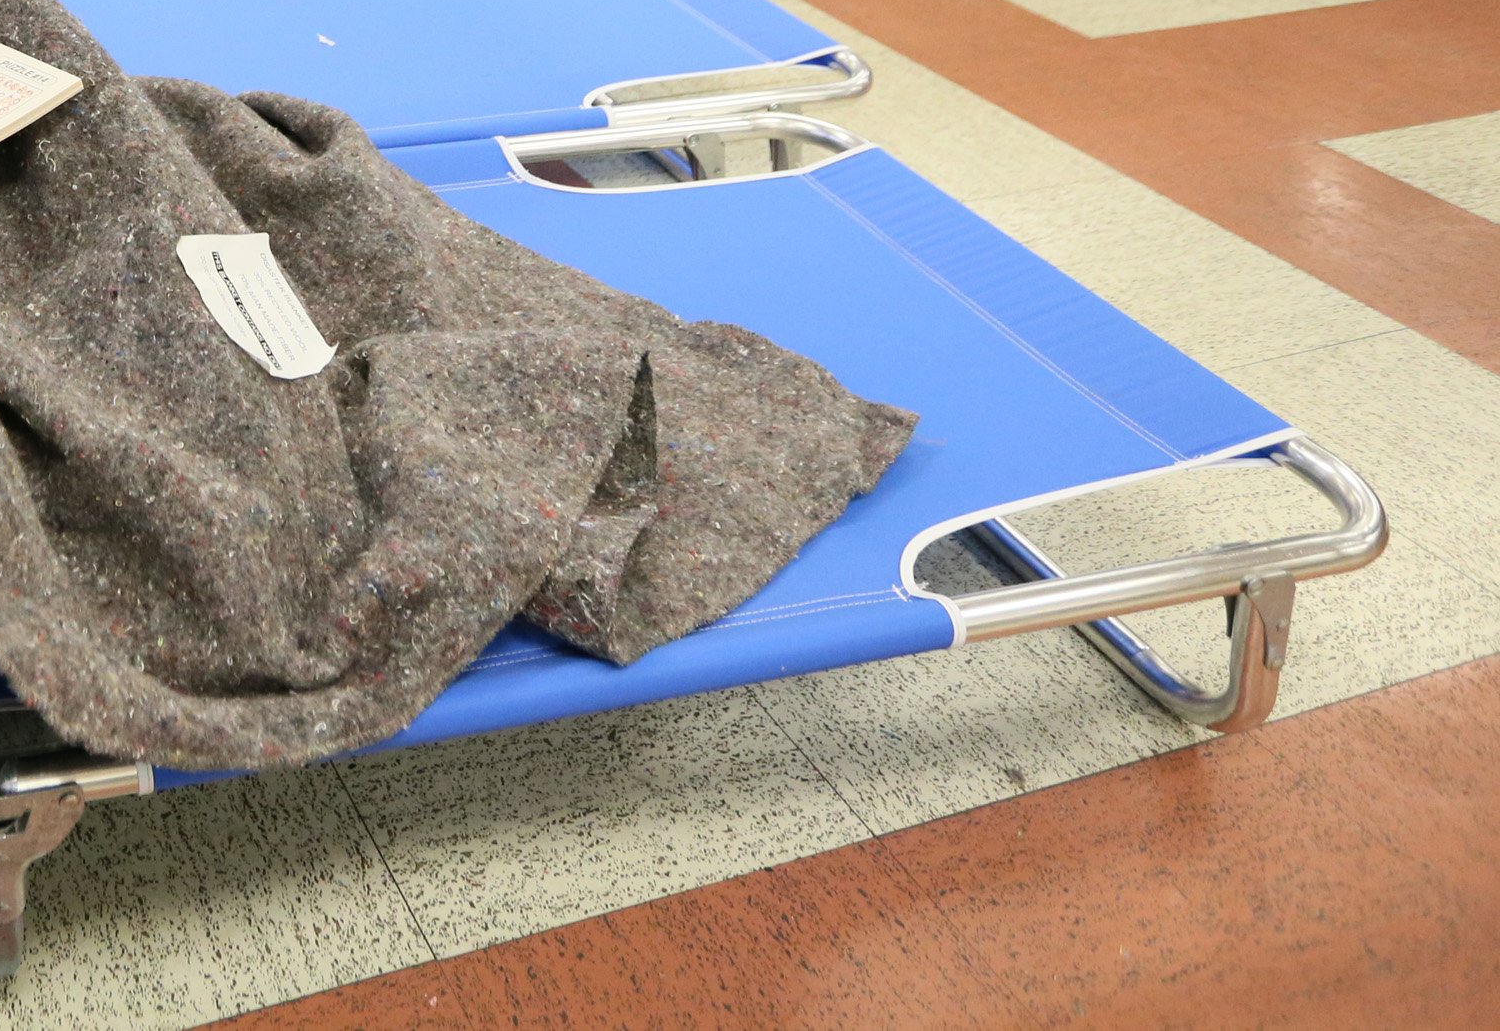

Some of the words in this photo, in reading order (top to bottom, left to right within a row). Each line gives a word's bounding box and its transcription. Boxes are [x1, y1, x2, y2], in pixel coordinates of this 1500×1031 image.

[0, 60, 33, 76] PUZZLE
[259, 252, 285, 292] DISASTER
[283, 292, 309, 329] BLANKET
[260, 341, 272, 354] NO
[276, 335, 296, 362] FIBER
